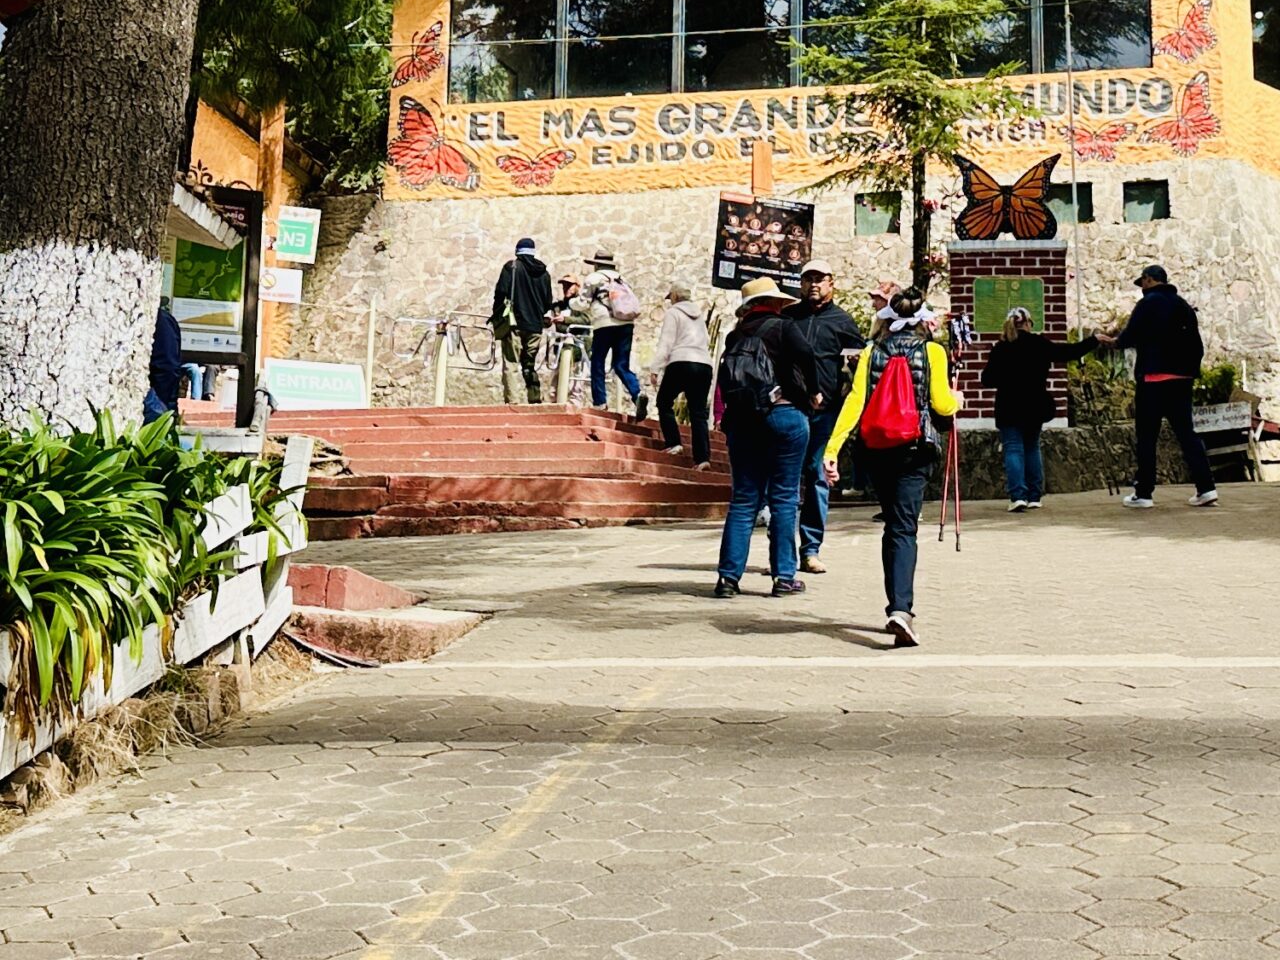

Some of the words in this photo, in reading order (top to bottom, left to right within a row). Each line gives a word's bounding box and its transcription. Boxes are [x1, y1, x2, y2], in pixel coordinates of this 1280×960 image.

[469, 110, 519, 141] EL
[543, 105, 637, 139] MAS
[591, 139, 716, 166] EJIDO
[276, 373, 355, 392] ENTRADA
